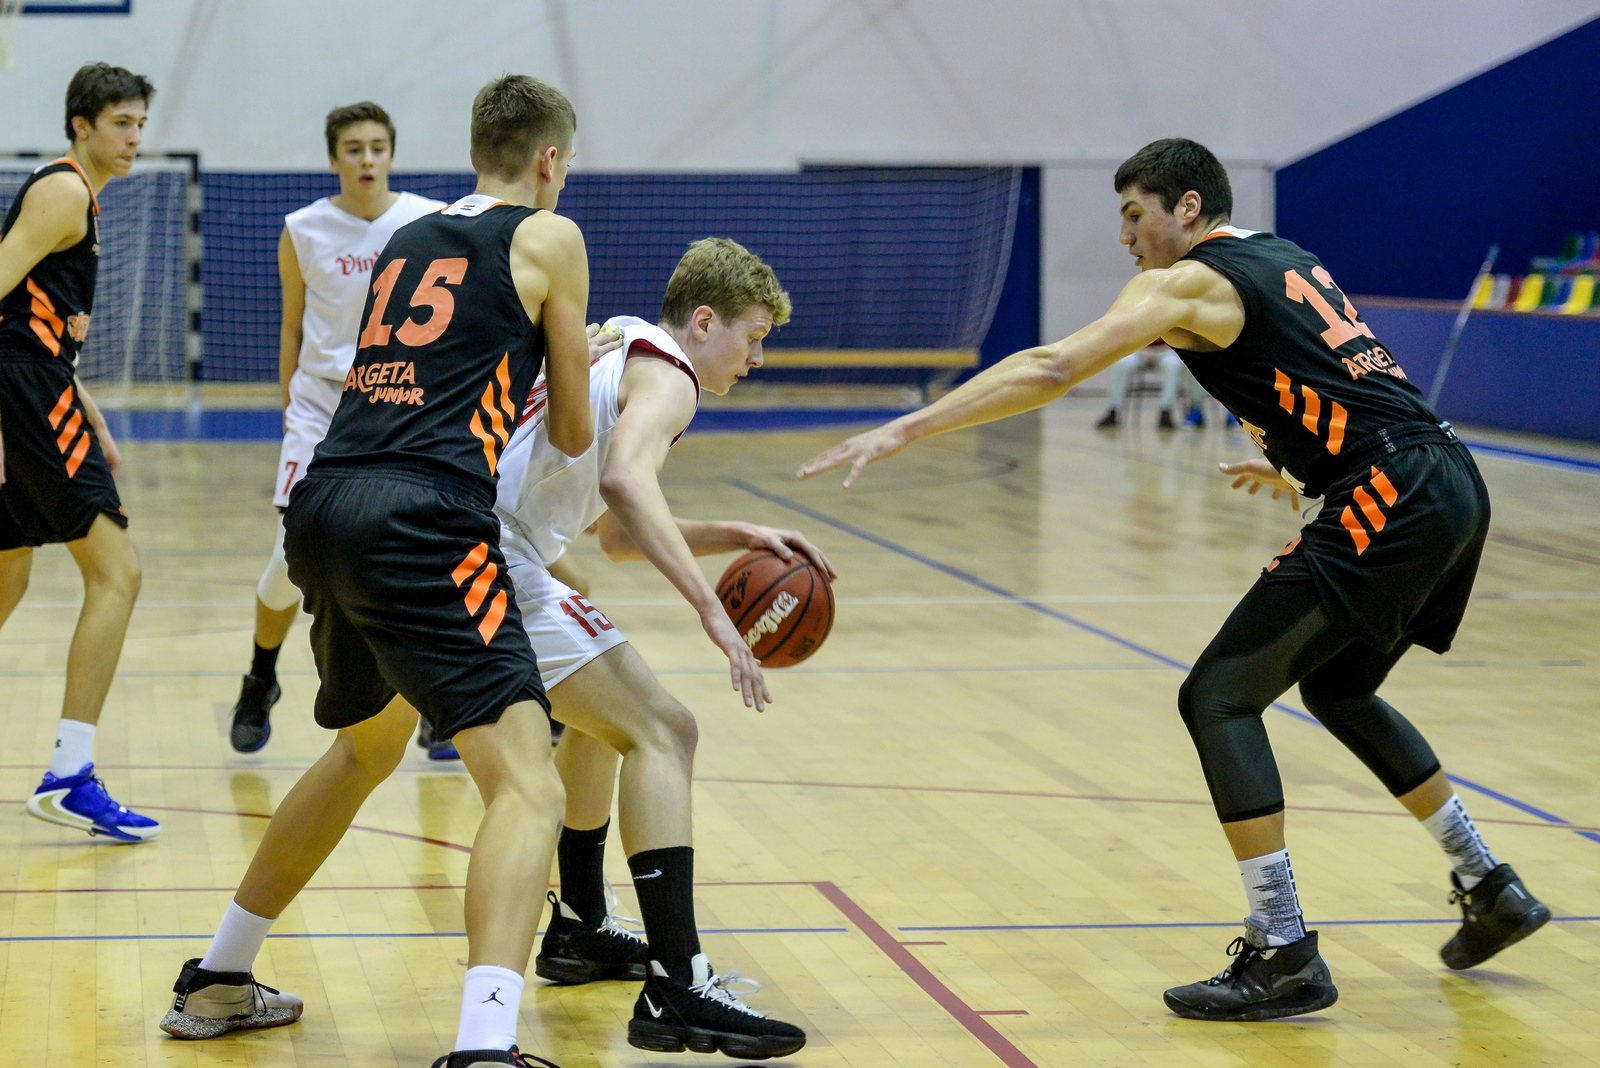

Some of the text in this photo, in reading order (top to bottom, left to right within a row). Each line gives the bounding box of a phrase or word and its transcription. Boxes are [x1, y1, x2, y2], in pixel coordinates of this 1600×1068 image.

[358, 257, 469, 349] 15
[1284, 265, 1377, 350] 12
[343, 361, 416, 393] ARGETA
[369, 387, 425, 406] JUNIOR
[283, 461, 299, 496] 7
[559, 595, 616, 639] 15
